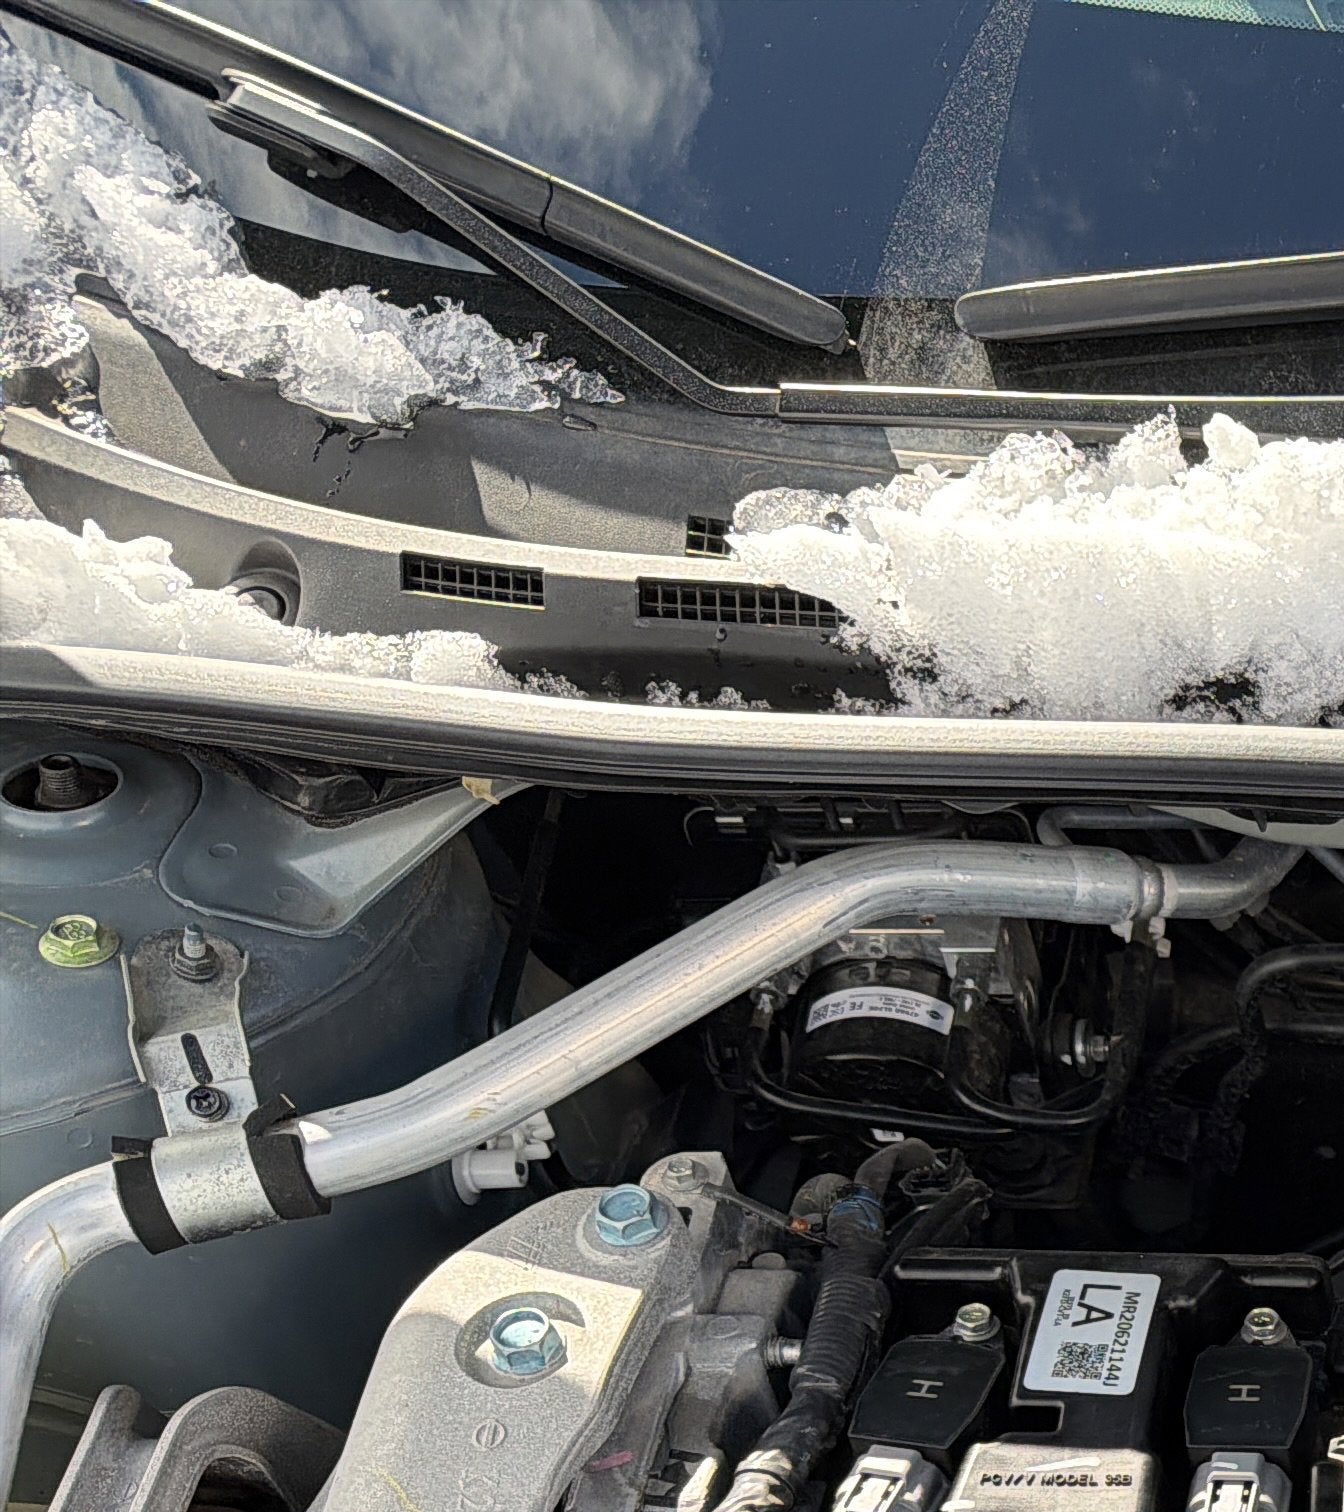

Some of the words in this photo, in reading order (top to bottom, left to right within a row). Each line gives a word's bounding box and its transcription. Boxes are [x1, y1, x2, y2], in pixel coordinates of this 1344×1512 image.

[1070, 1283, 1122, 1326] LA
[1102, 1291, 1141, 1387] MR20621144J
[1041, 1473, 1098, 1486] MODEL
